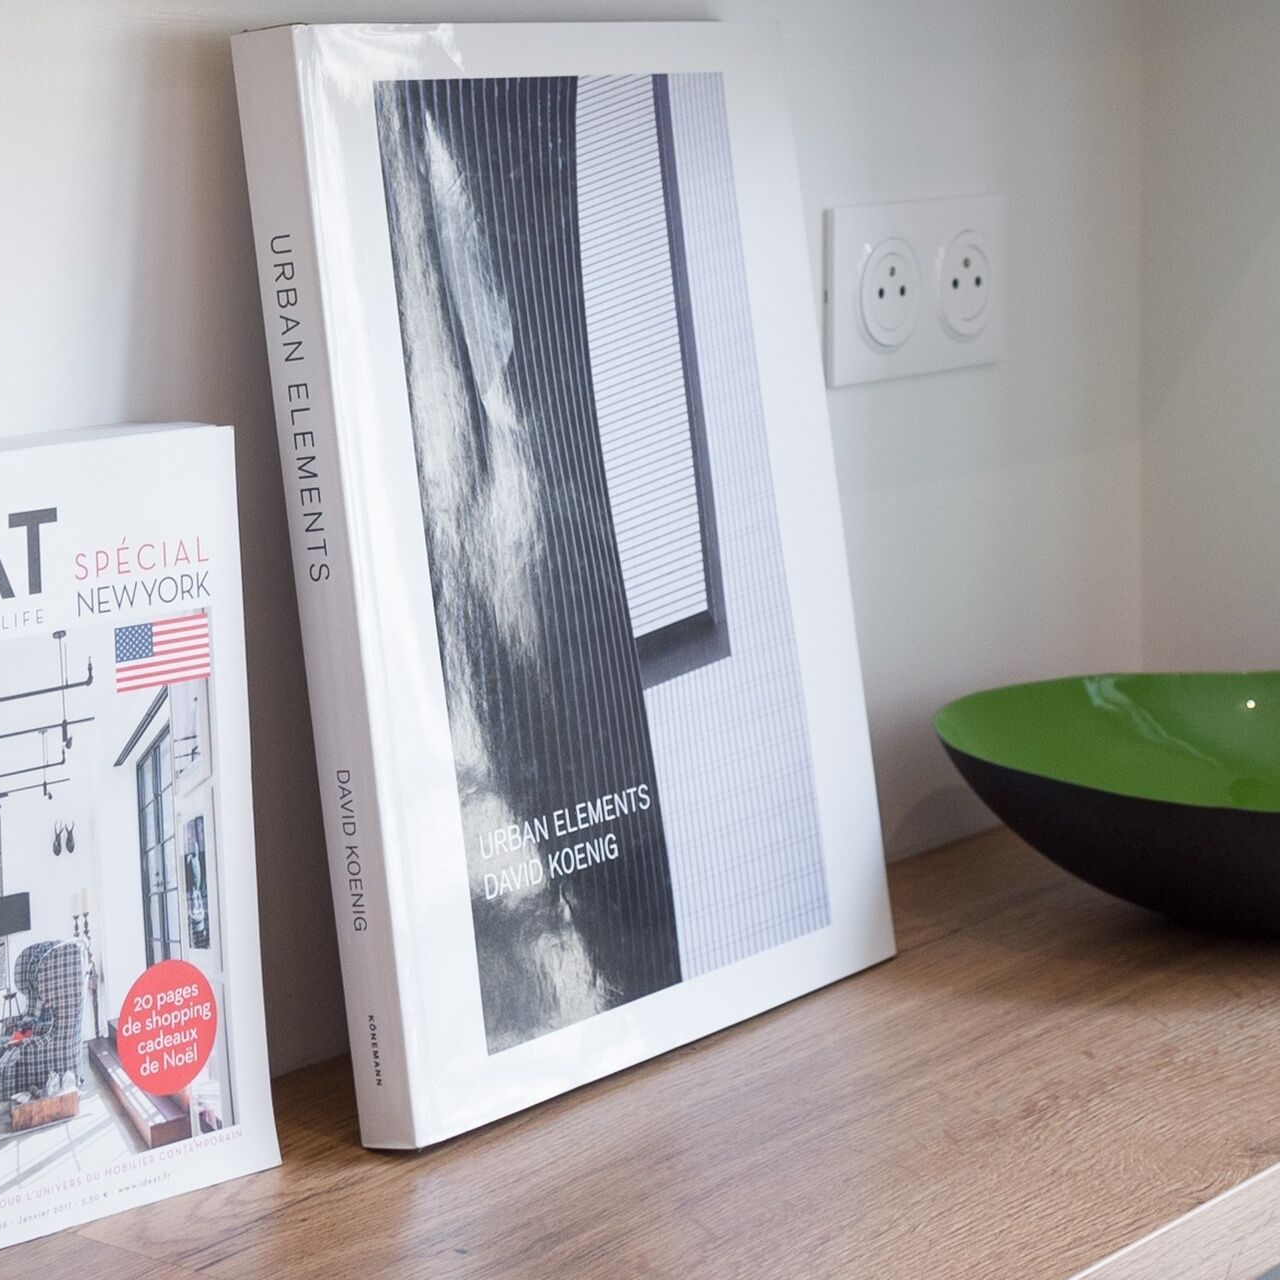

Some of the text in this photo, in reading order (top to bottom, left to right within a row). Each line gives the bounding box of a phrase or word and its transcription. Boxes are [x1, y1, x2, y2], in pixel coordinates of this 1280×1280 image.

[270, 234, 331, 583] URBAN ELEMENTS
[74, 536, 210, 581] SPÉCIAL
[1, 607, 45, 630] LIFE
[480, 783, 651, 861] URBAN ELEMENTS
[336, 768, 369, 933] DAVID KOENIG
[484, 833, 620, 901] DAVID KOENIG
[122, 1002, 212, 1037] de shopping
[133, 983, 199, 1013] 20 pages
[137, 1028, 199, 1055] cadeaux
[140, 1042, 198, 1076] de Noël
[85, 1170, 101, 1184] DU
[105, 1155, 155, 1178] MOBILIER
[159, 1129, 243, 1161] CONTEMPORAIN
